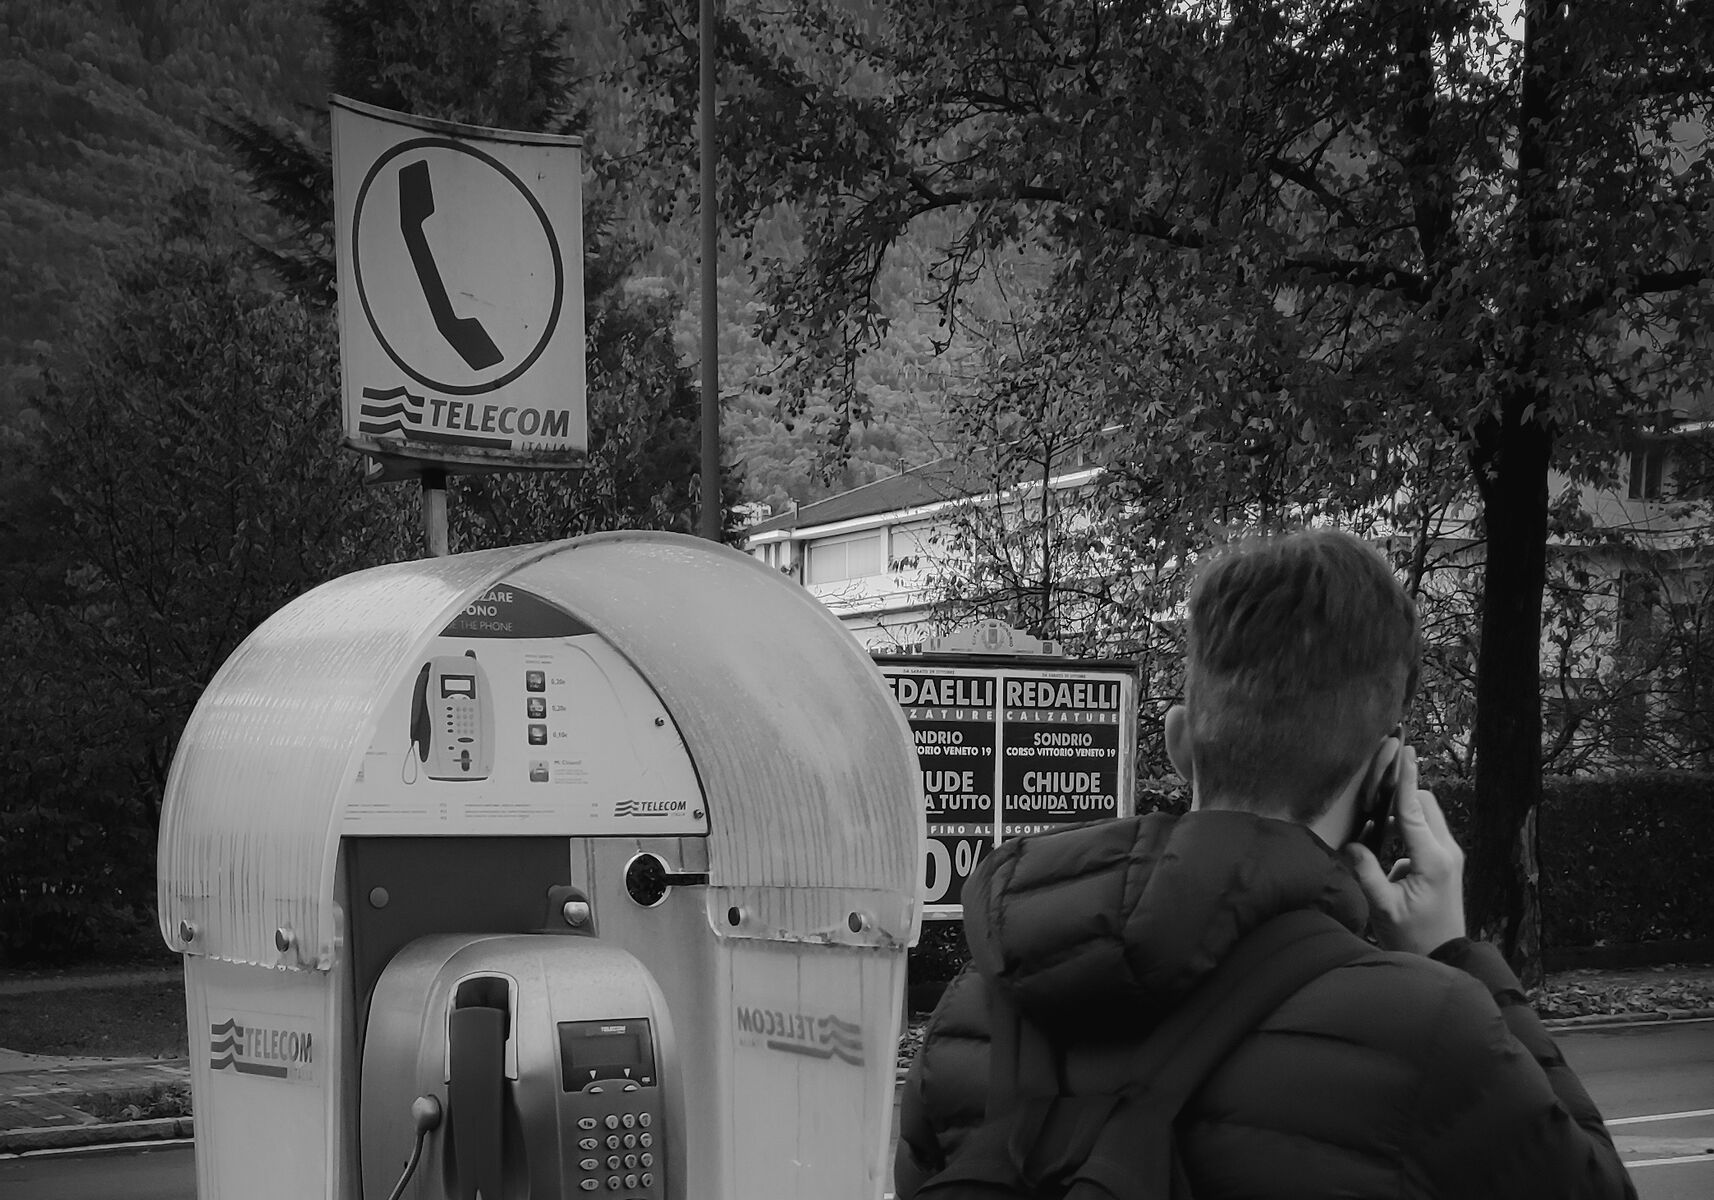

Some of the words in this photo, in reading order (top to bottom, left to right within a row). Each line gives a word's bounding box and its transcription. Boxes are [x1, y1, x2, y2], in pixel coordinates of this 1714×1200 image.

[430, 399, 570, 437] TELECOM
[465, 605, 498, 616] ONO
[480, 621, 513, 632] PHONE
[1006, 681, 1118, 709] REDAELLI
[909, 709, 993, 720] ZATURE
[1006, 711, 1117, 723] CALZATURE
[915, 730, 964, 744] NDRIO
[1033, 732, 1093, 746] SONDRIO
[916, 746, 942, 755] ORIO
[943, 746, 979, 756] VENETO
[981, 746, 992, 756] 19
[1006, 747, 1035, 756] CORSO
[1036, 747, 1074, 757] VITTORIO
[1075, 748, 1105, 757] VENETO
[1106, 748, 1116, 757] 19
[922, 771, 974, 793] UDE
[1022, 771, 1101, 793] CHIUDE
[641, 800, 687, 811] TELECOM
[940, 794, 992, 810] TUTTO
[1005, 794, 1068, 811] LIQUIDA
[1071, 795, 1115, 810] TUTTO
[931, 825, 965, 834] FINO
[974, 825, 991, 834] AL
[923, 839, 983, 902] 0%
[245, 1027, 313, 1063] TELECOM
